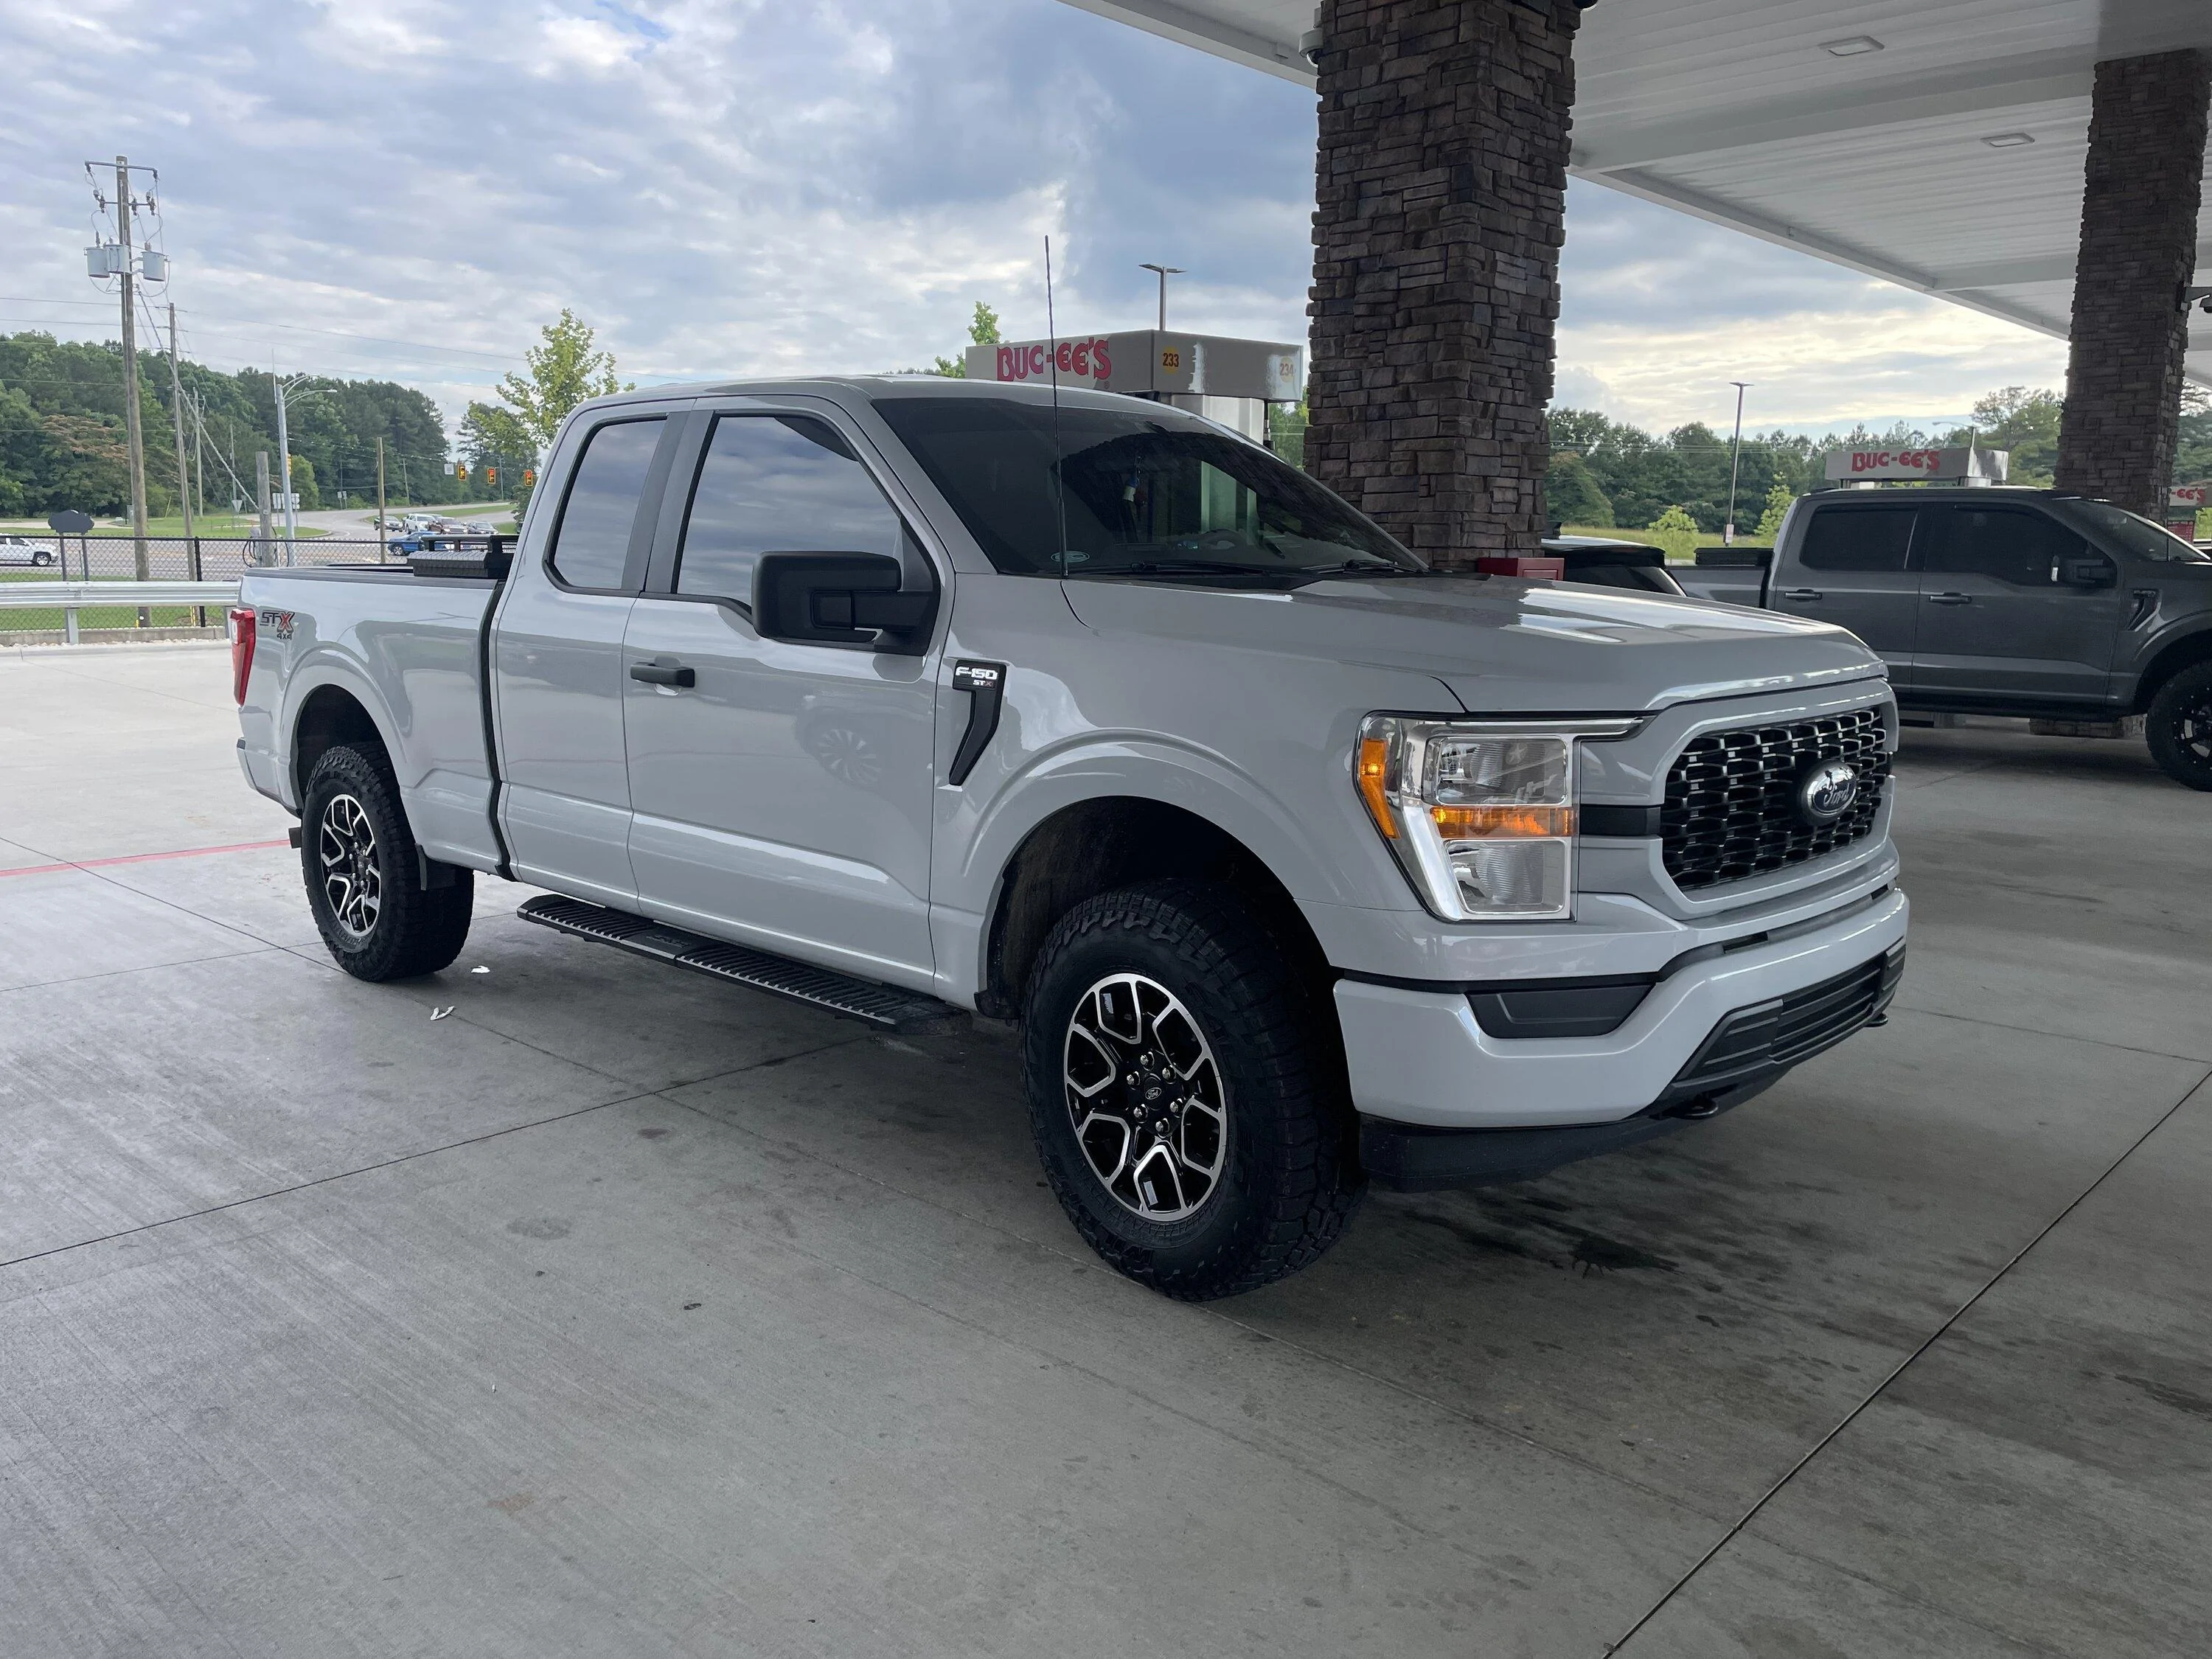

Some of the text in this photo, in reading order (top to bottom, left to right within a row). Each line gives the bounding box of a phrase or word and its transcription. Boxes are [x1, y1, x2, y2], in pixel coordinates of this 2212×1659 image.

[1163, 352, 1179, 367] 233
[1280, 363, 1295, 377] 234
[1851, 449, 1940, 472] BUC-EE'S
[2171, 487, 2206, 504] -EE'S
[260, 610, 295, 633] STX
[956, 667, 998, 680] F-150
[973, 679, 994, 687] STX
